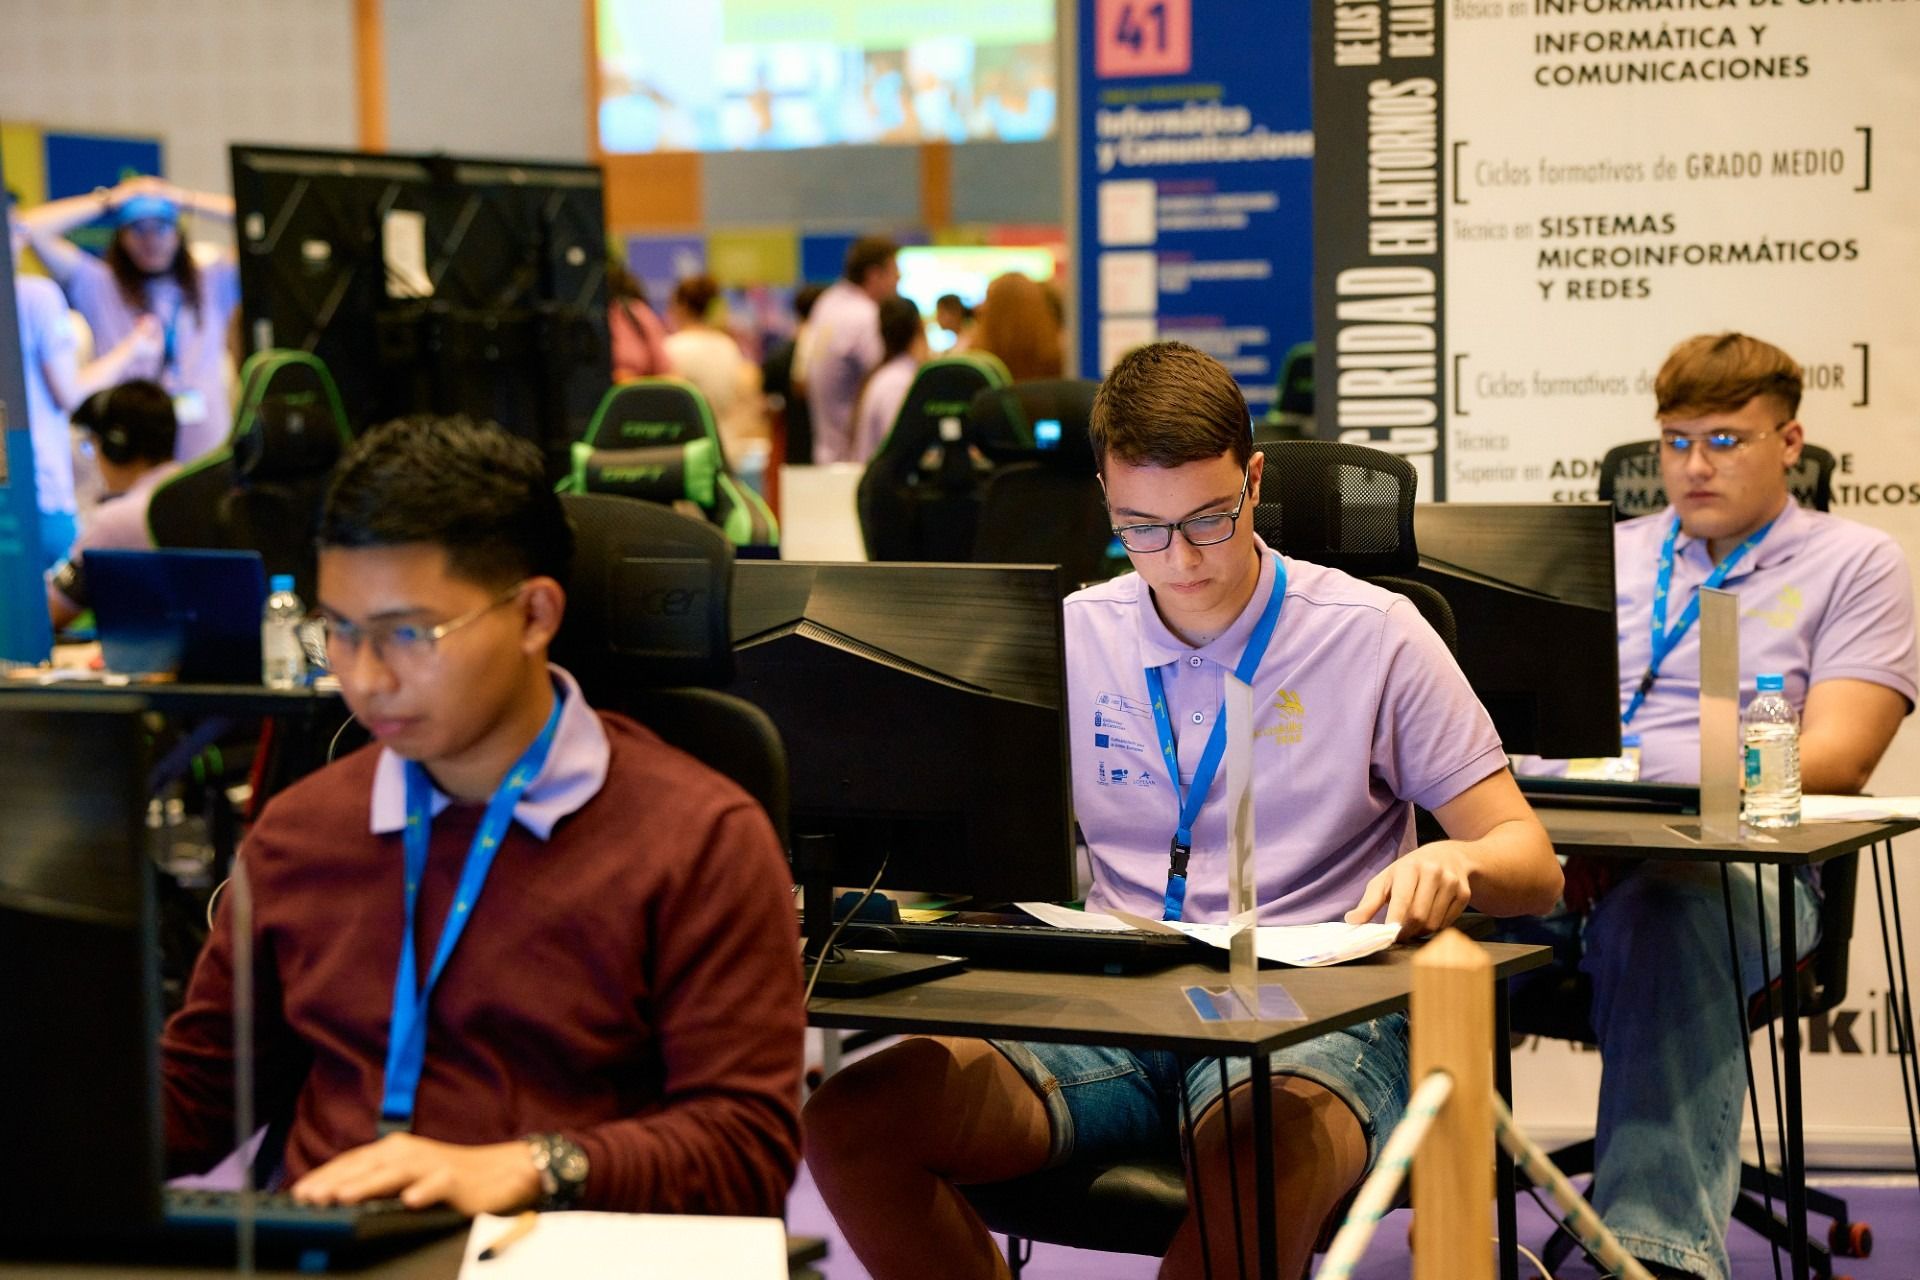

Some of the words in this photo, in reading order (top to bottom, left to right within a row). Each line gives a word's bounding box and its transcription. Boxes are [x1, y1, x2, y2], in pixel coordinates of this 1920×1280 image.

[1115, 4, 1166, 53] 41
[1535, 23, 1736, 54] INFORMÁTICA
[1749, 24, 1767, 46] Y
[1534, 55, 1810, 86] COMUNICACIONES
[1368, 77, 1437, 217] ENTORNOS
[1686, 151, 1762, 180] GRADO
[1771, 148, 1844, 176] MEDIO
[1368, 220, 1437, 255] EN
[1540, 213, 1676, 239] SISTEMAS
[1538, 233, 1859, 269] MICROINFORMÁTICOS
[1540, 281, 1553, 300] Y
[1566, 278, 1651, 299] REDES
[1336, 266, 1438, 500] GURIDAD
